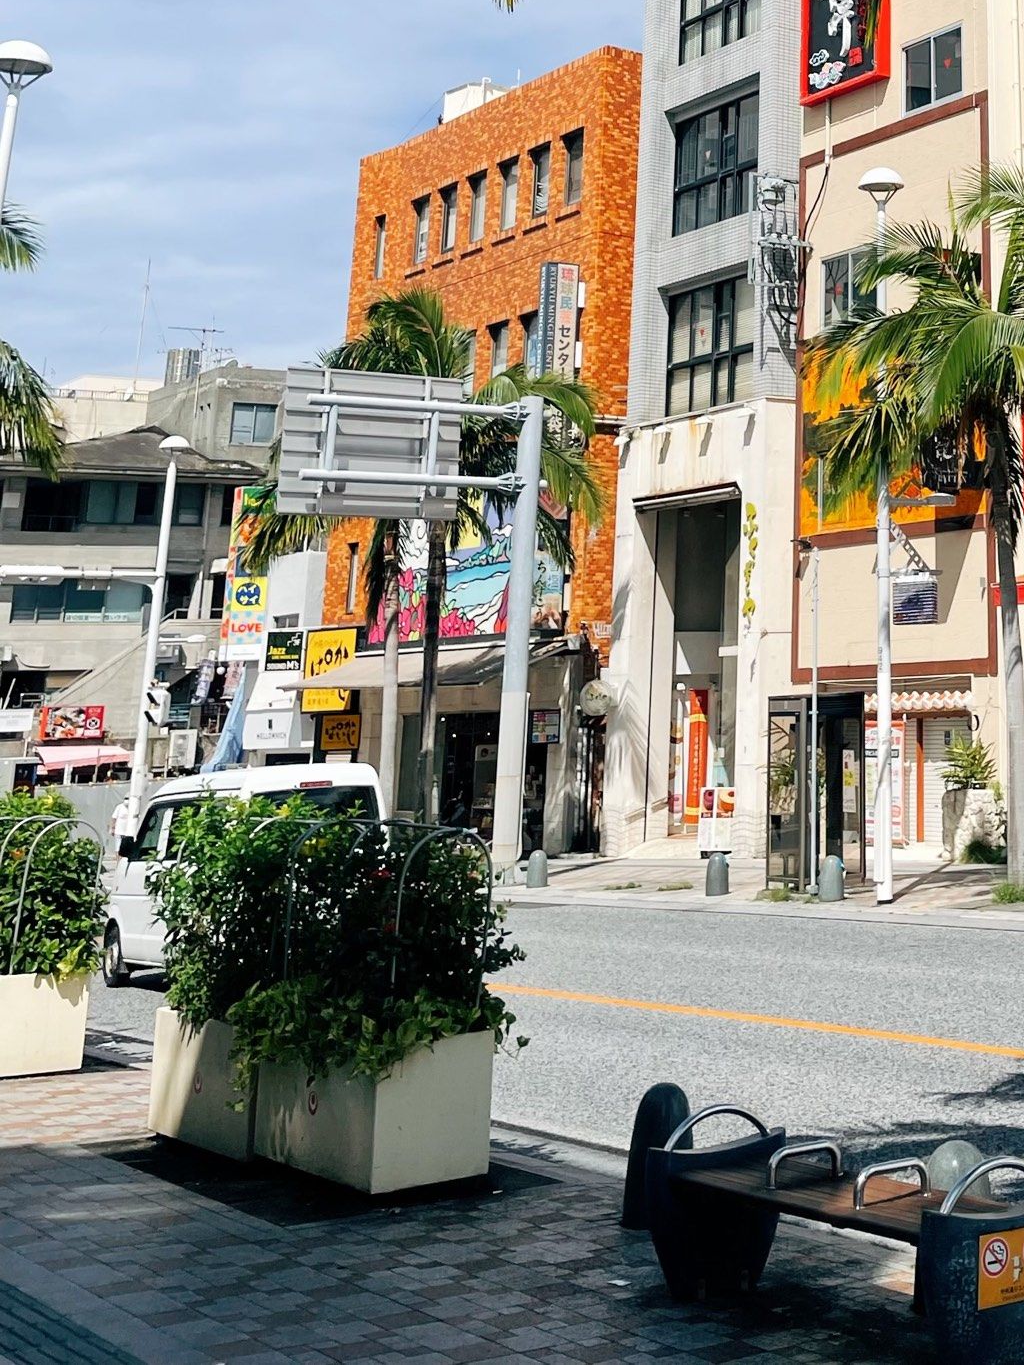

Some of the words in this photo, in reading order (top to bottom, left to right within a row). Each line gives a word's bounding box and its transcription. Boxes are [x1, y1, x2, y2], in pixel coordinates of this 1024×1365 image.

[549, 266, 557, 302] RYUKYU
[547, 304, 555, 340] MINGEI
[231, 622, 262, 633] LOVE
[268, 645, 287, 655] Jazz
